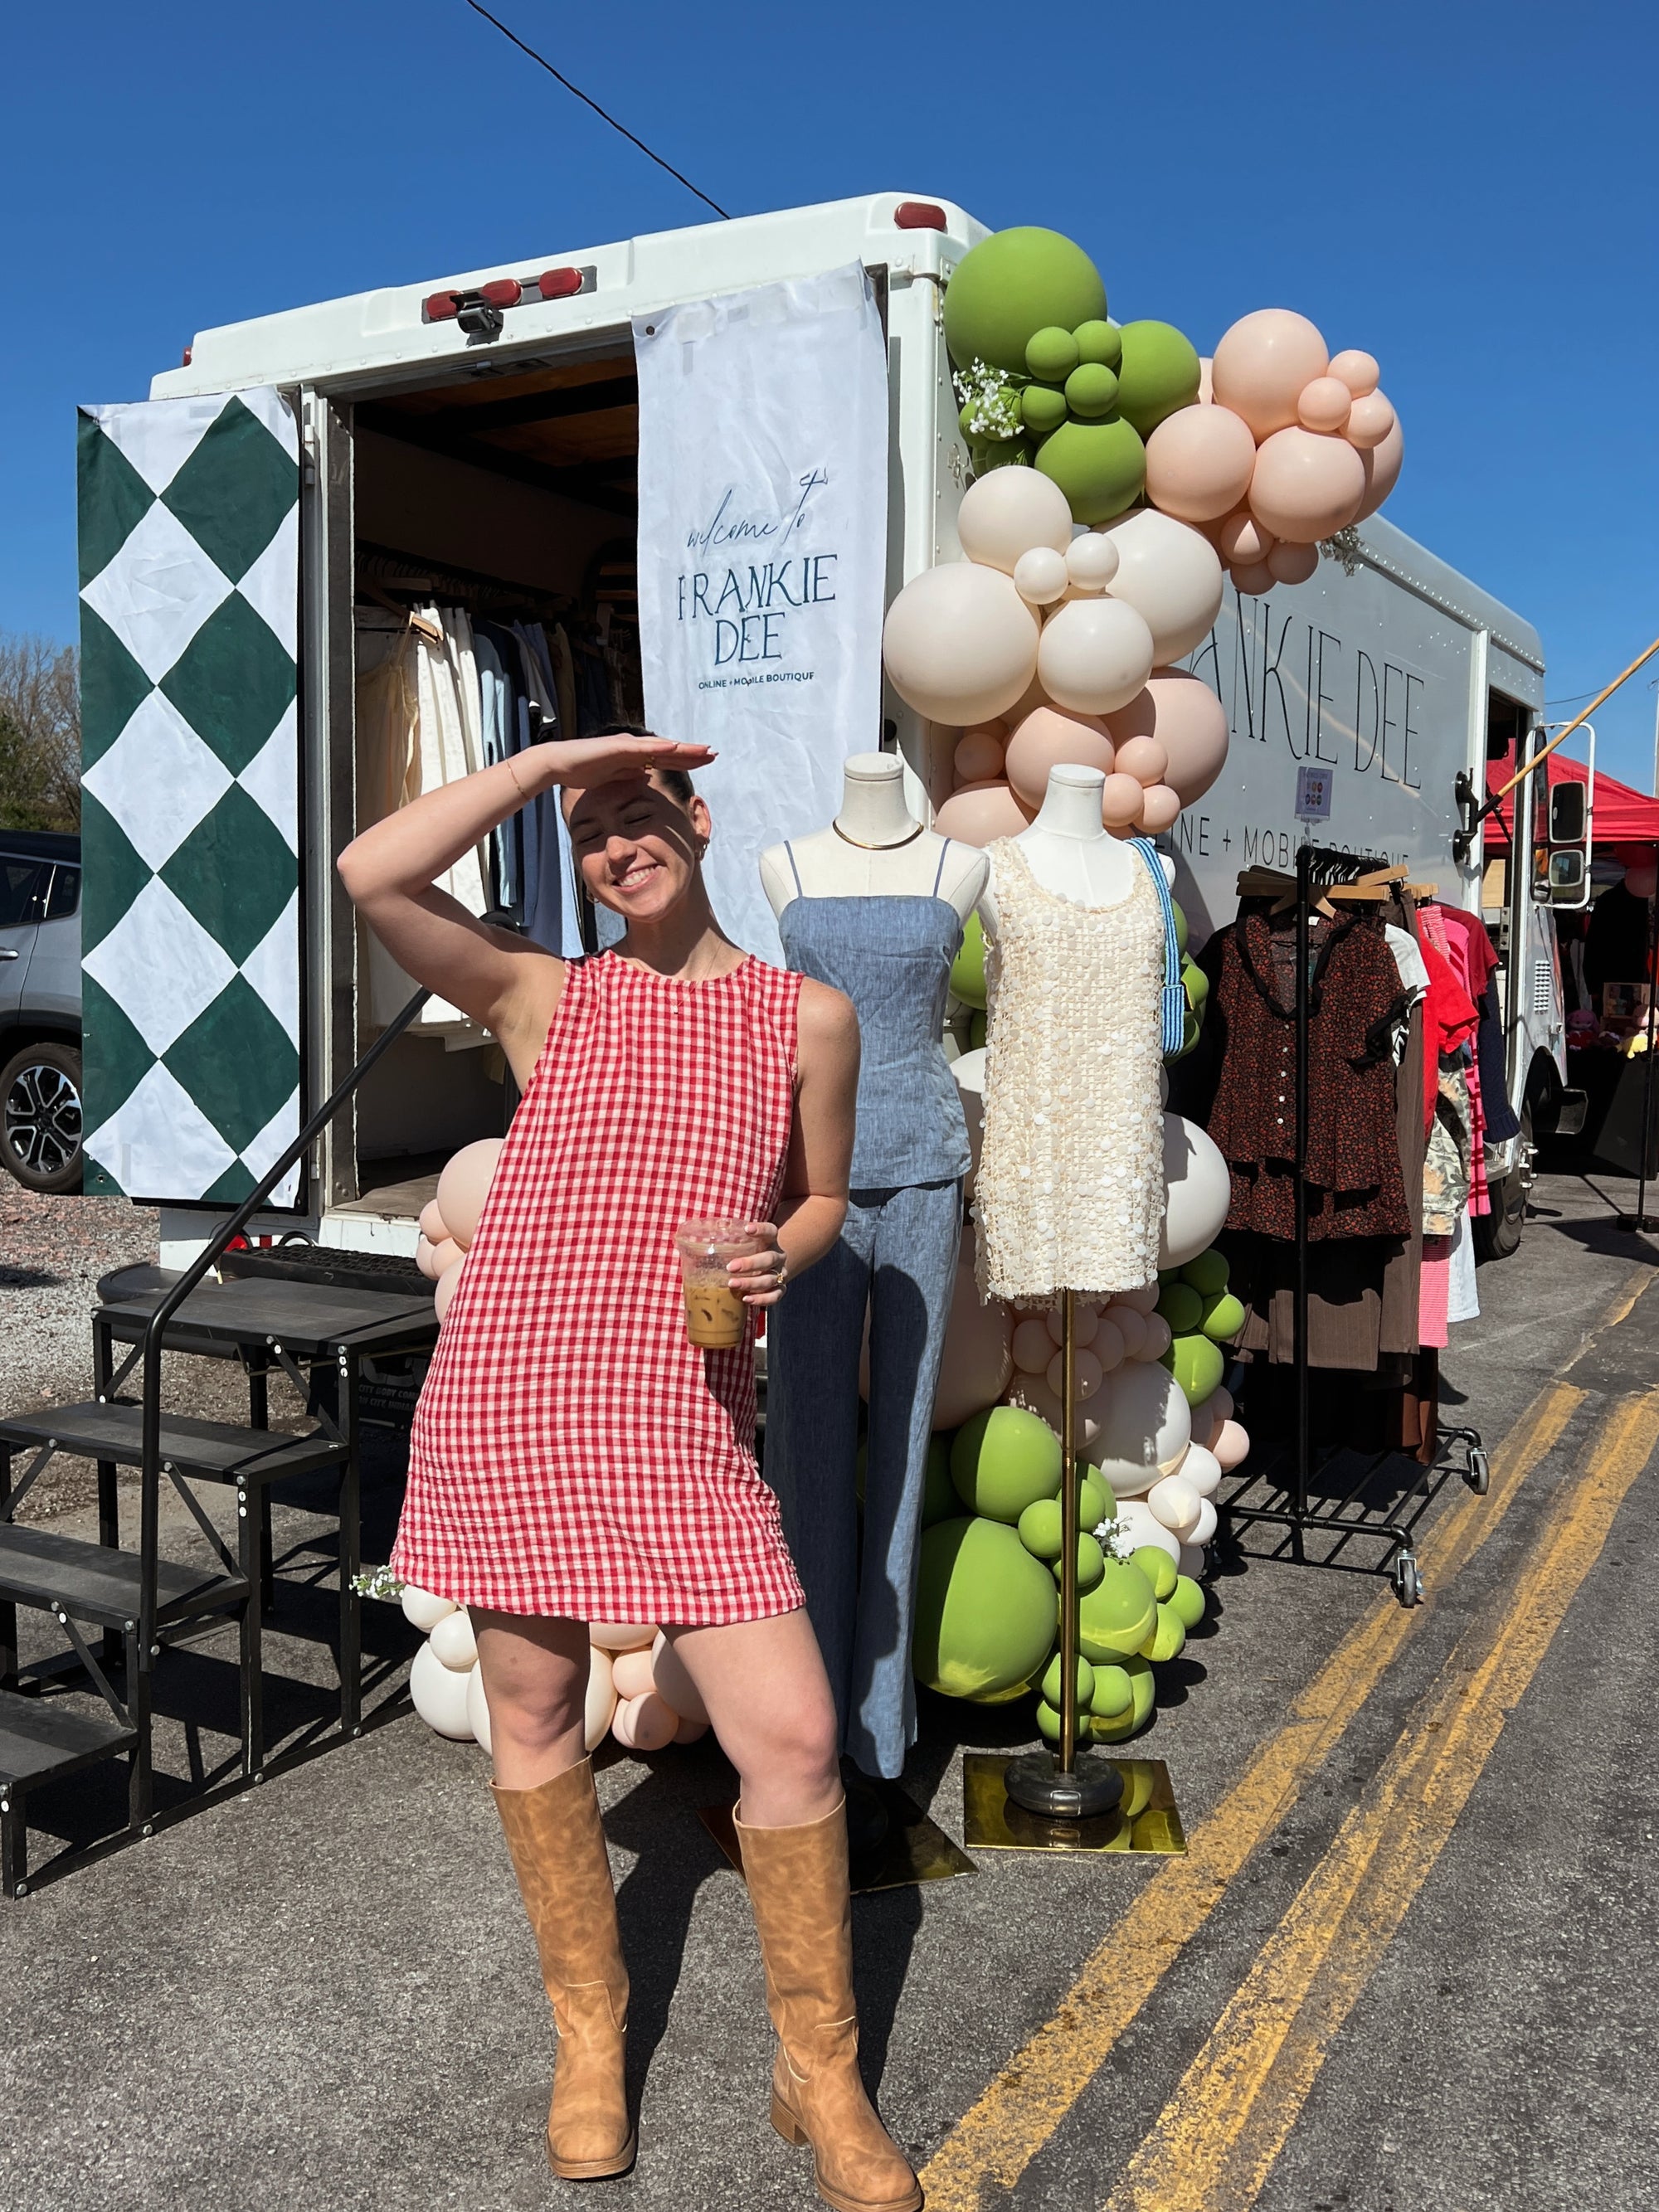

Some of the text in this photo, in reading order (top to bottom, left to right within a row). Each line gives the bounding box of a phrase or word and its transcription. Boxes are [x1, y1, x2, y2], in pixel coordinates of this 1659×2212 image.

[687, 467, 829, 556] welcome to
[679, 553, 837, 620] FRANKIE
[713, 611, 786, 666] DEE
[698, 679, 727, 690] ONLINE
[1189, 589, 1424, 789] ANKIE DEE
